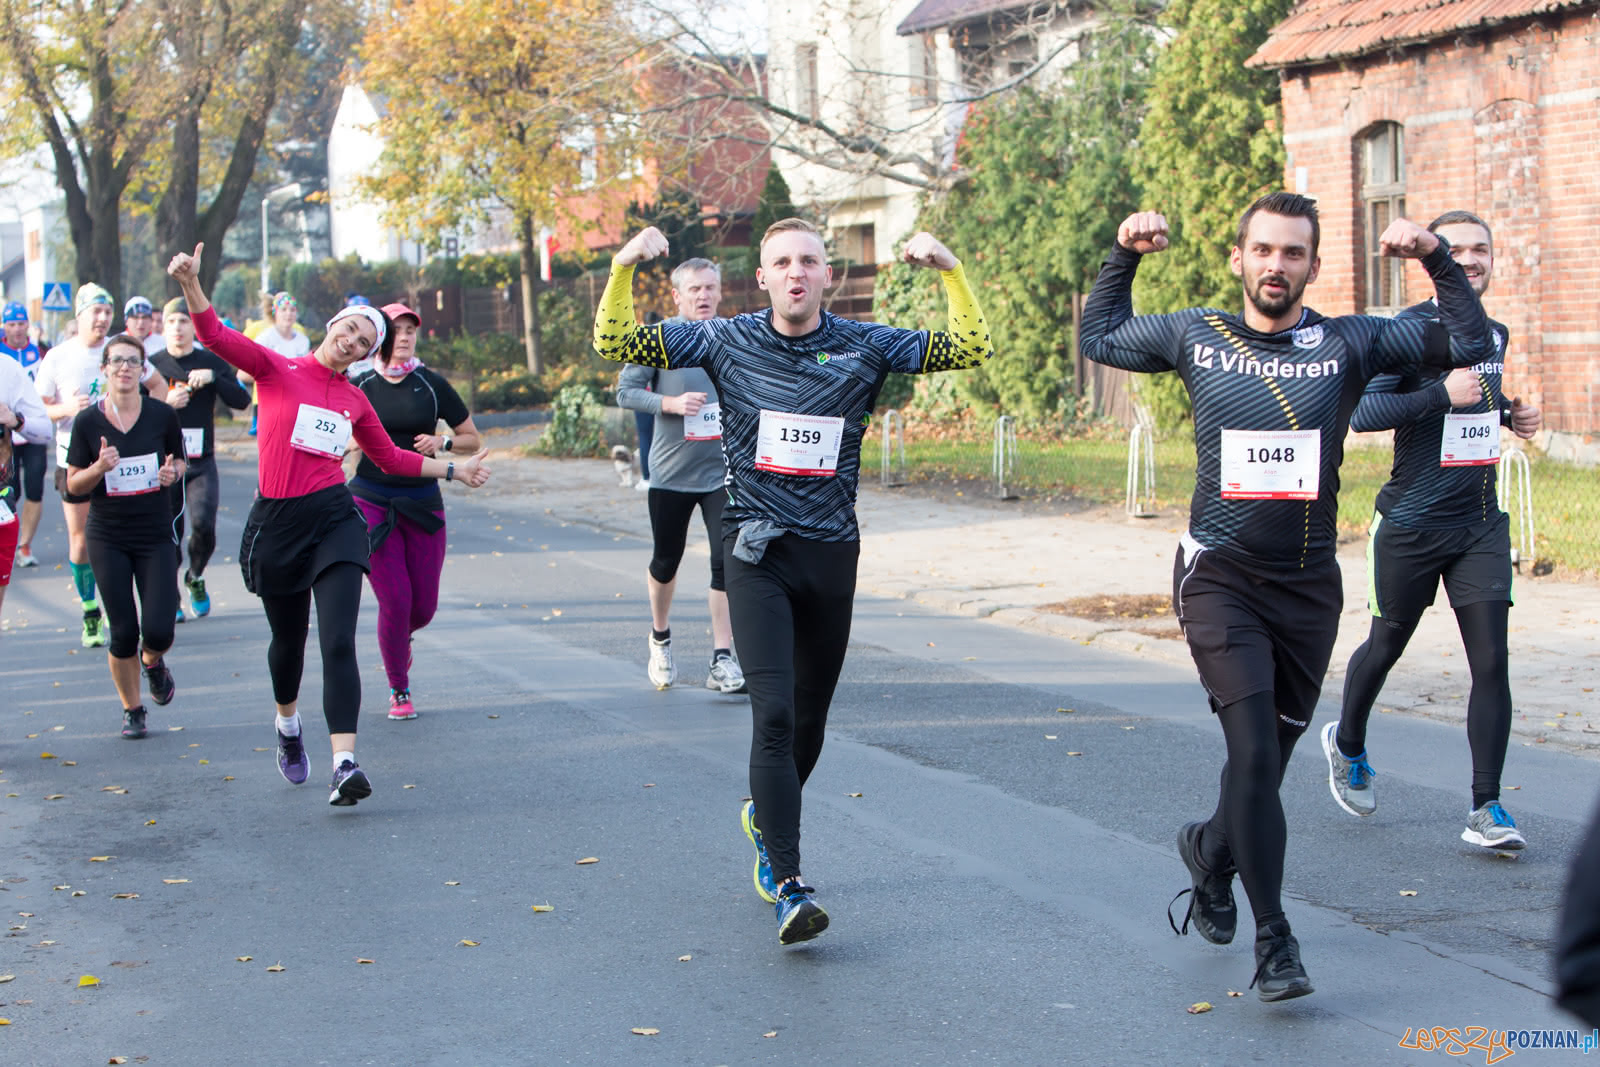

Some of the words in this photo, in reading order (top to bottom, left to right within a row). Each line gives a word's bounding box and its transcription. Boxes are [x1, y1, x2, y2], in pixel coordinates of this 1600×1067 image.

[831, 351, 861, 361] motion
[1219, 350, 1339, 378] Vinderen
[315, 418, 337, 434] 252
[1460, 425, 1491, 439] 1049
[780, 427, 822, 445] 1359
[1247, 447, 1295, 463] 1048
[119, 465, 146, 477] 1293
